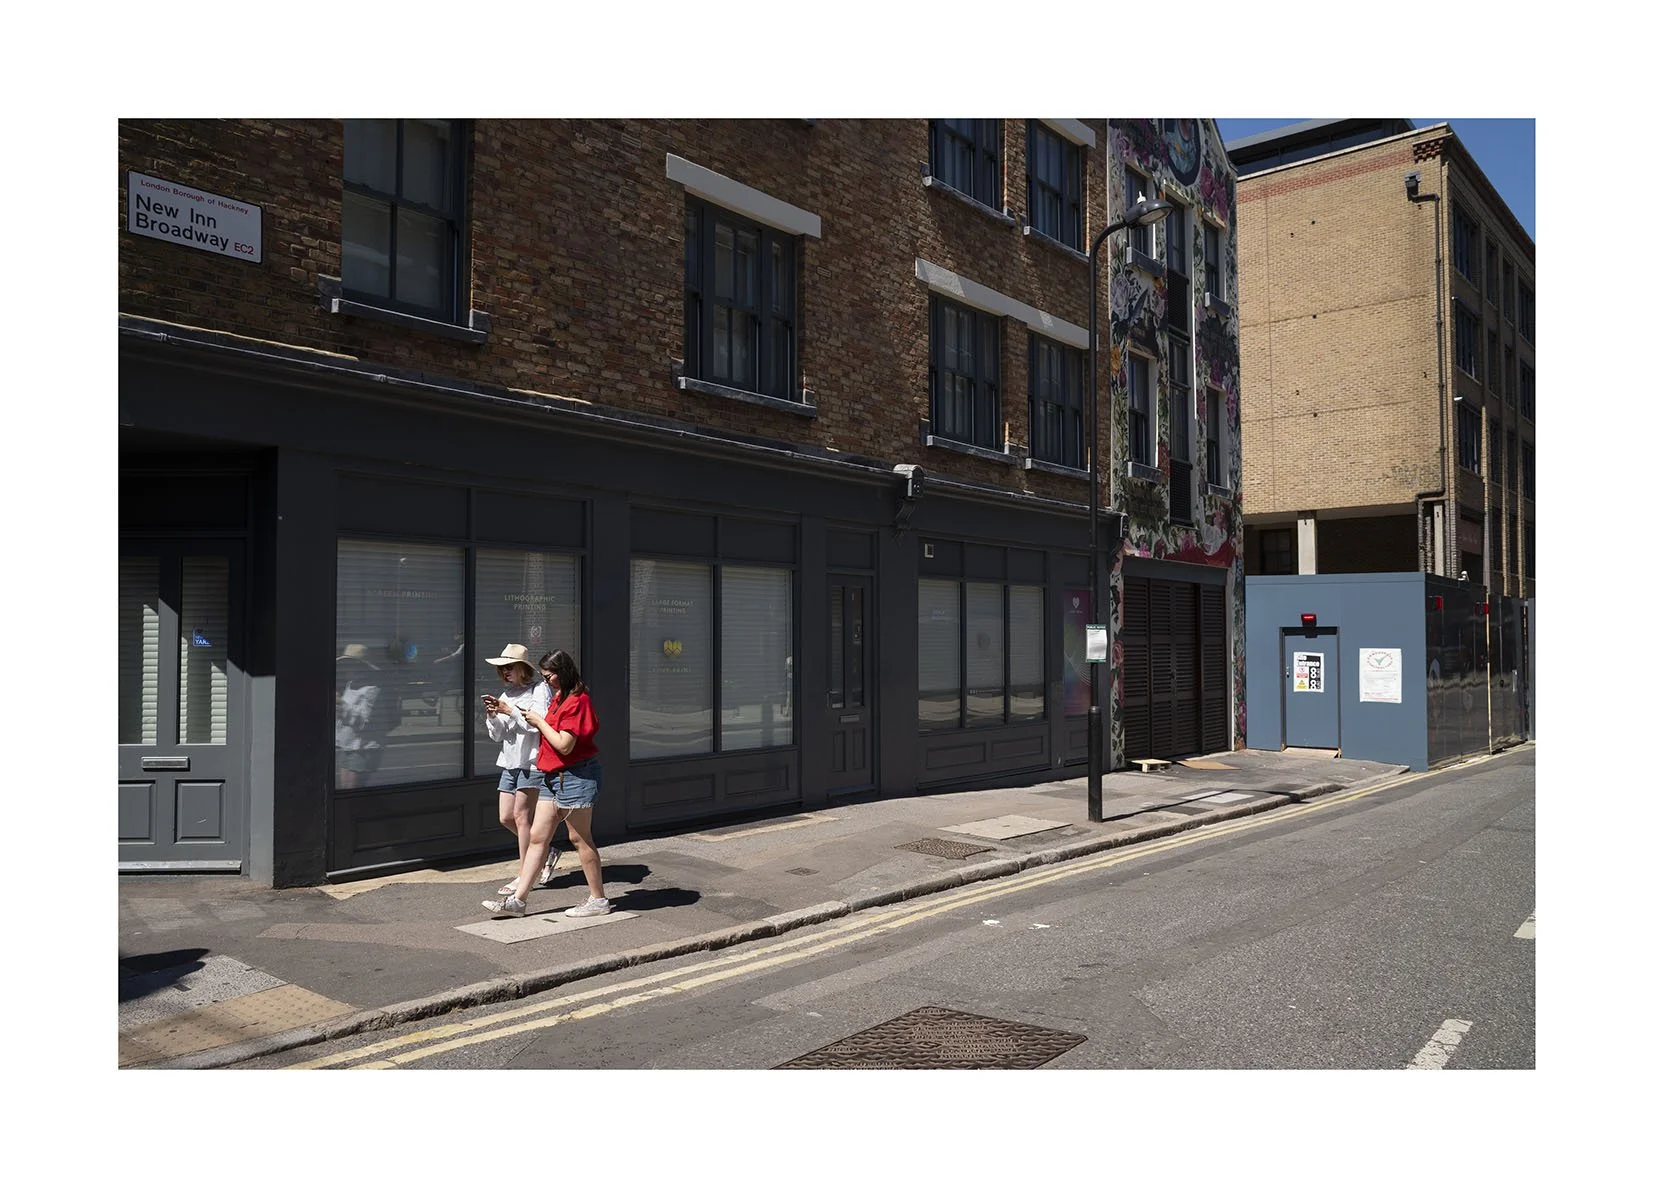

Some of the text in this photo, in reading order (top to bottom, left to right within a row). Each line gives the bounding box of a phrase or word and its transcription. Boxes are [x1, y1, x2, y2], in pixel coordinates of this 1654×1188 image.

[136, 193, 217, 229] New Inn
[140, 178, 249, 216] London Borough of Hackney
[135, 211, 255, 256] Broadway EC2
[504, 594, 556, 603] LITHOGRAPHIC
